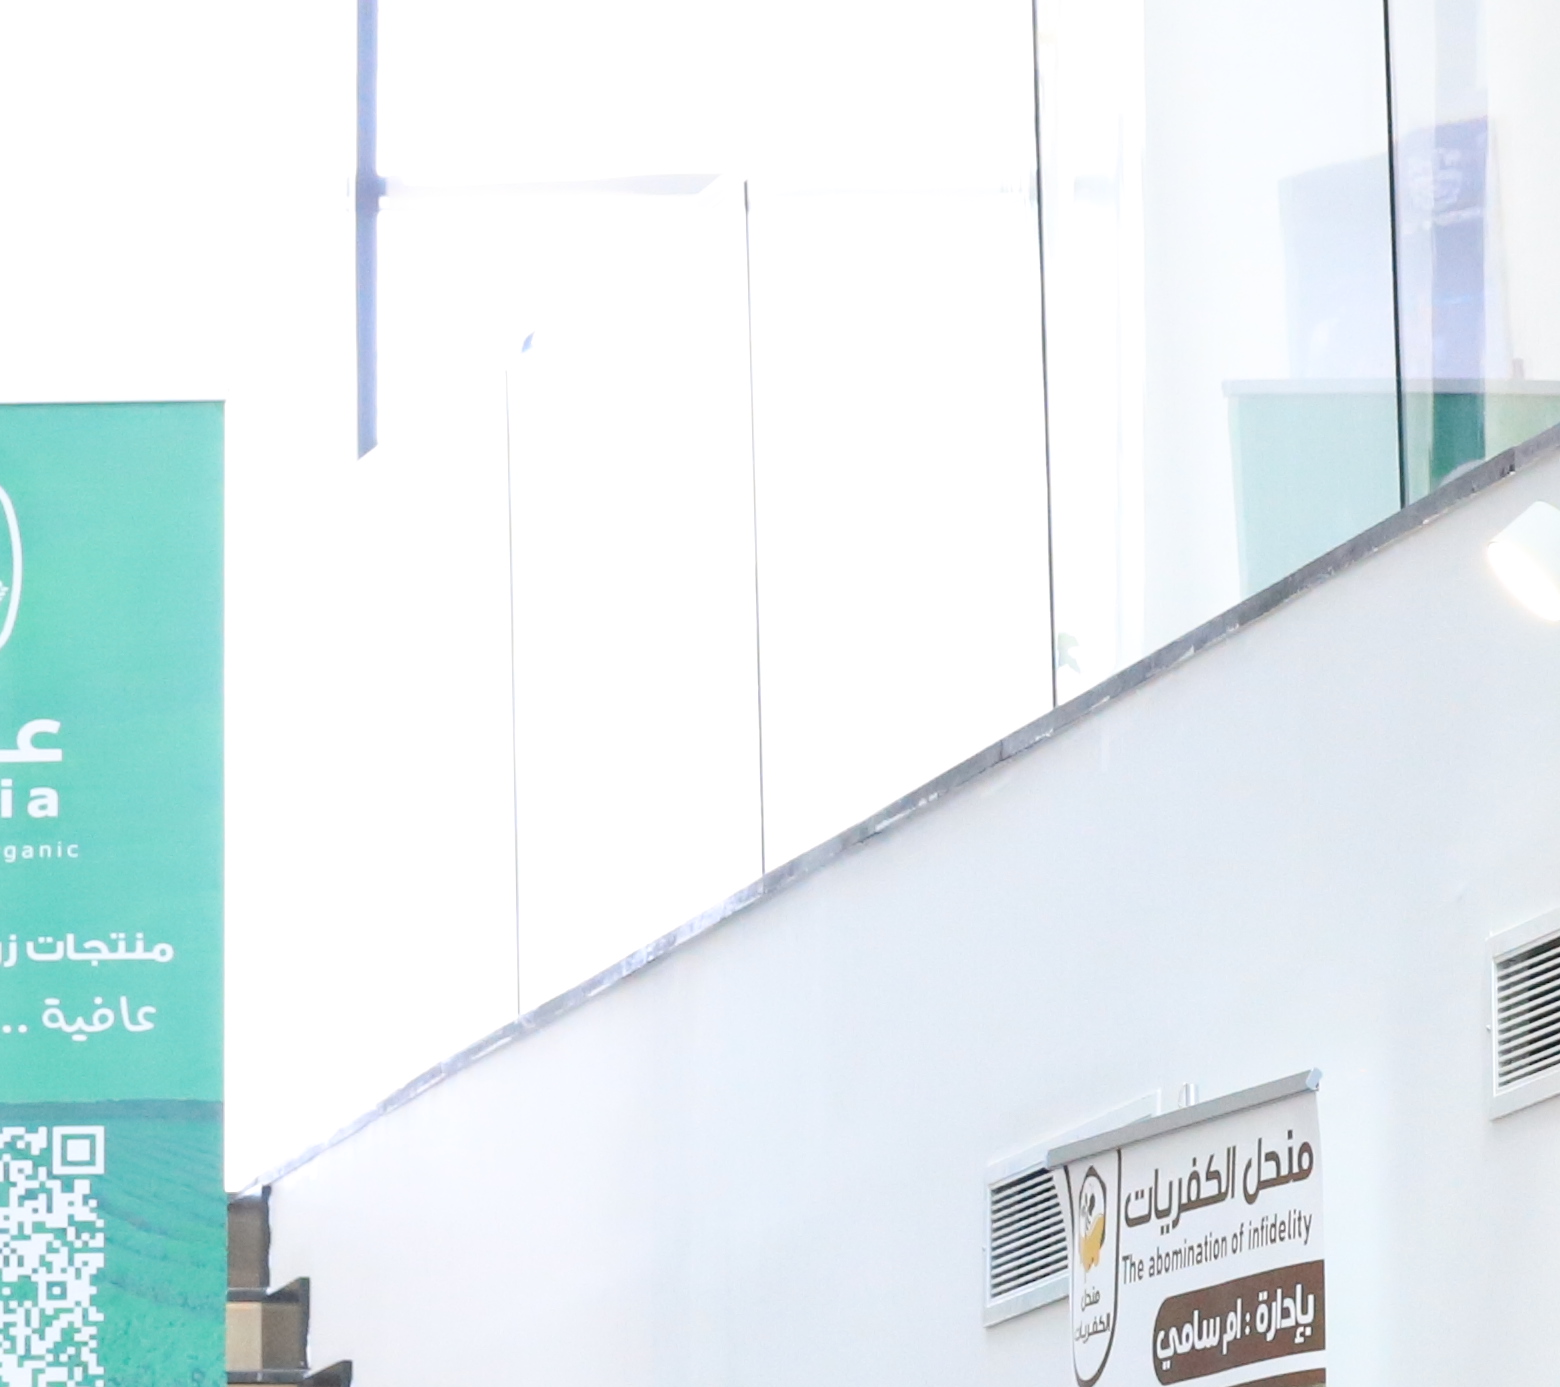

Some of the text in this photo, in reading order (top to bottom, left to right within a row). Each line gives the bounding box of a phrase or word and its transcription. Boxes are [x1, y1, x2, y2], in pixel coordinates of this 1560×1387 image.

[27, 932, 174, 967] منتجات
[42, 997, 157, 1042] عافية
[1124, 1130, 1314, 1236] منحل الكفريات
[1122, 1208, 1313, 1285] The abomination of infidelity
[1081, 1286, 1101, 1312] منحل
[1255, 1283, 1315, 1344] بإدارة
[1156, 1310, 1221, 1370] سامي
